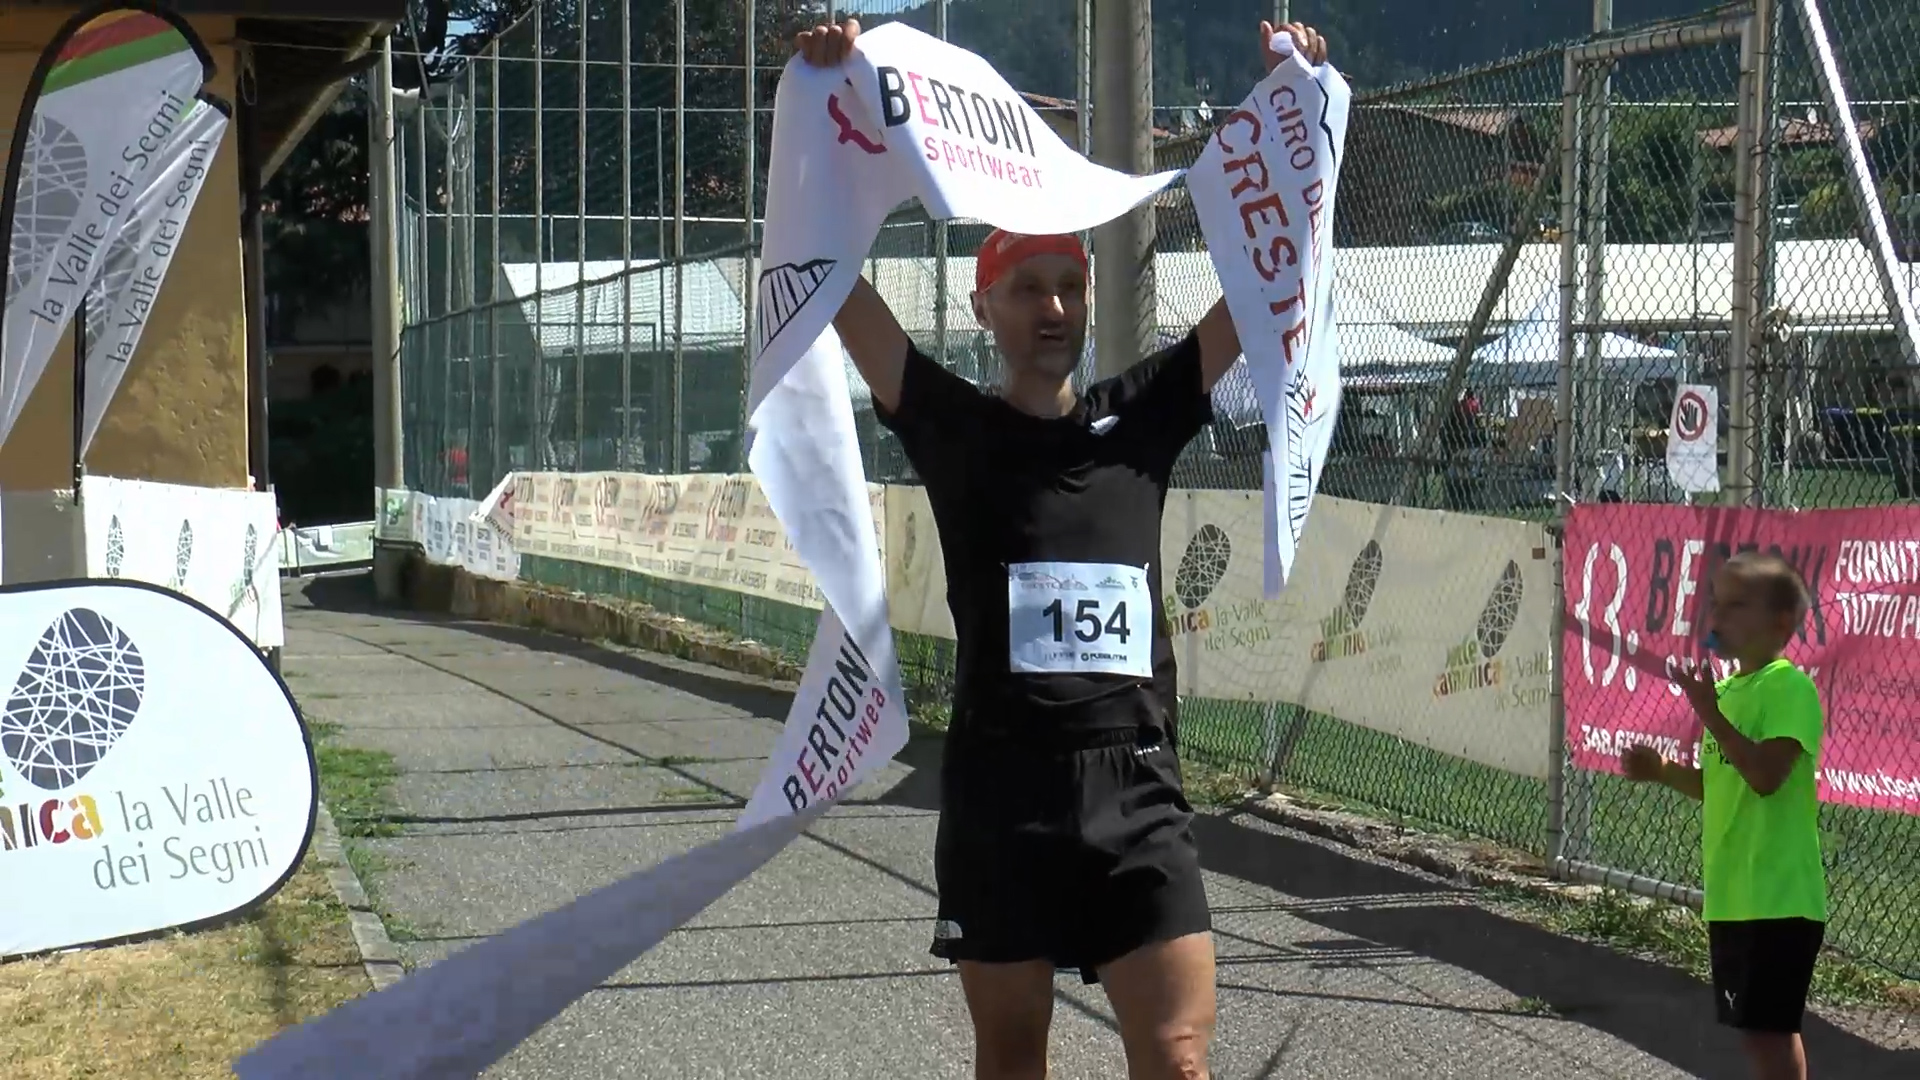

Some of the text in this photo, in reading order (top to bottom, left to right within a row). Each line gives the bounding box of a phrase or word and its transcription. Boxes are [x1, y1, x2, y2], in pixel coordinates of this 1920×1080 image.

[877, 66, 1036, 157] BERTONI
[1269, 85, 1315, 171] GIRO
[924, 136, 1043, 188] sportwear
[30, 90, 184, 325] la Valle dei Segni
[1215, 109, 1307, 365] CRESTE
[106, 139, 210, 365] la Valle dei Segni
[1835, 540, 1920, 584] FORNIT
[1043, 598, 1130, 644] 154
[1232, 599, 1266, 622] Valle
[1836, 592, 1901, 638] TUTTO
[782, 632, 871, 813] BERTONI
[116, 777, 258, 832] la Valle
[94, 826, 270, 890] dei Segni
